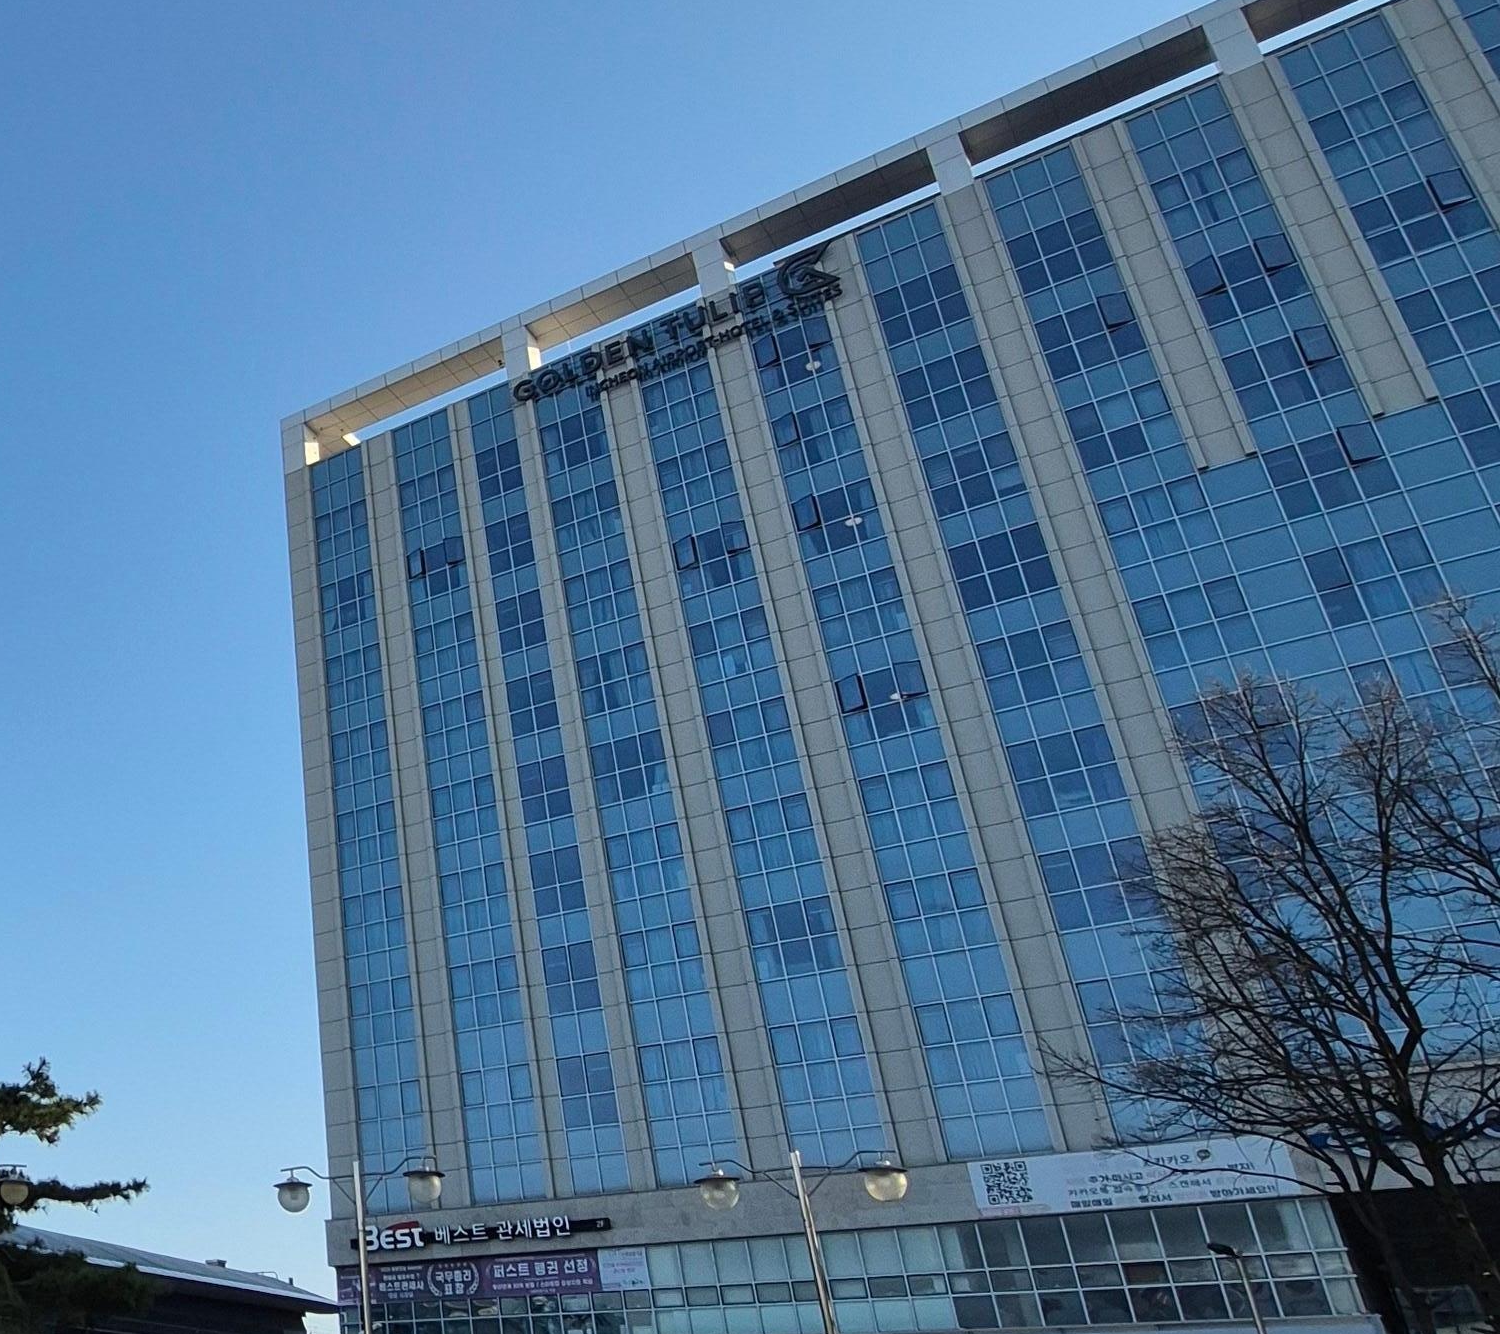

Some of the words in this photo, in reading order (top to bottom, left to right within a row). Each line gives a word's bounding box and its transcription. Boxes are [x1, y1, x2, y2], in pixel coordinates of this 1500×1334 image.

[513, 328, 654, 402] GOLDEN
[660, 281, 765, 340] TULIP
[434, 1222, 489, 1245] 베스트
[496, 1215, 571, 1241] 관세법인
[564, 1258, 589, 1274] 선정
